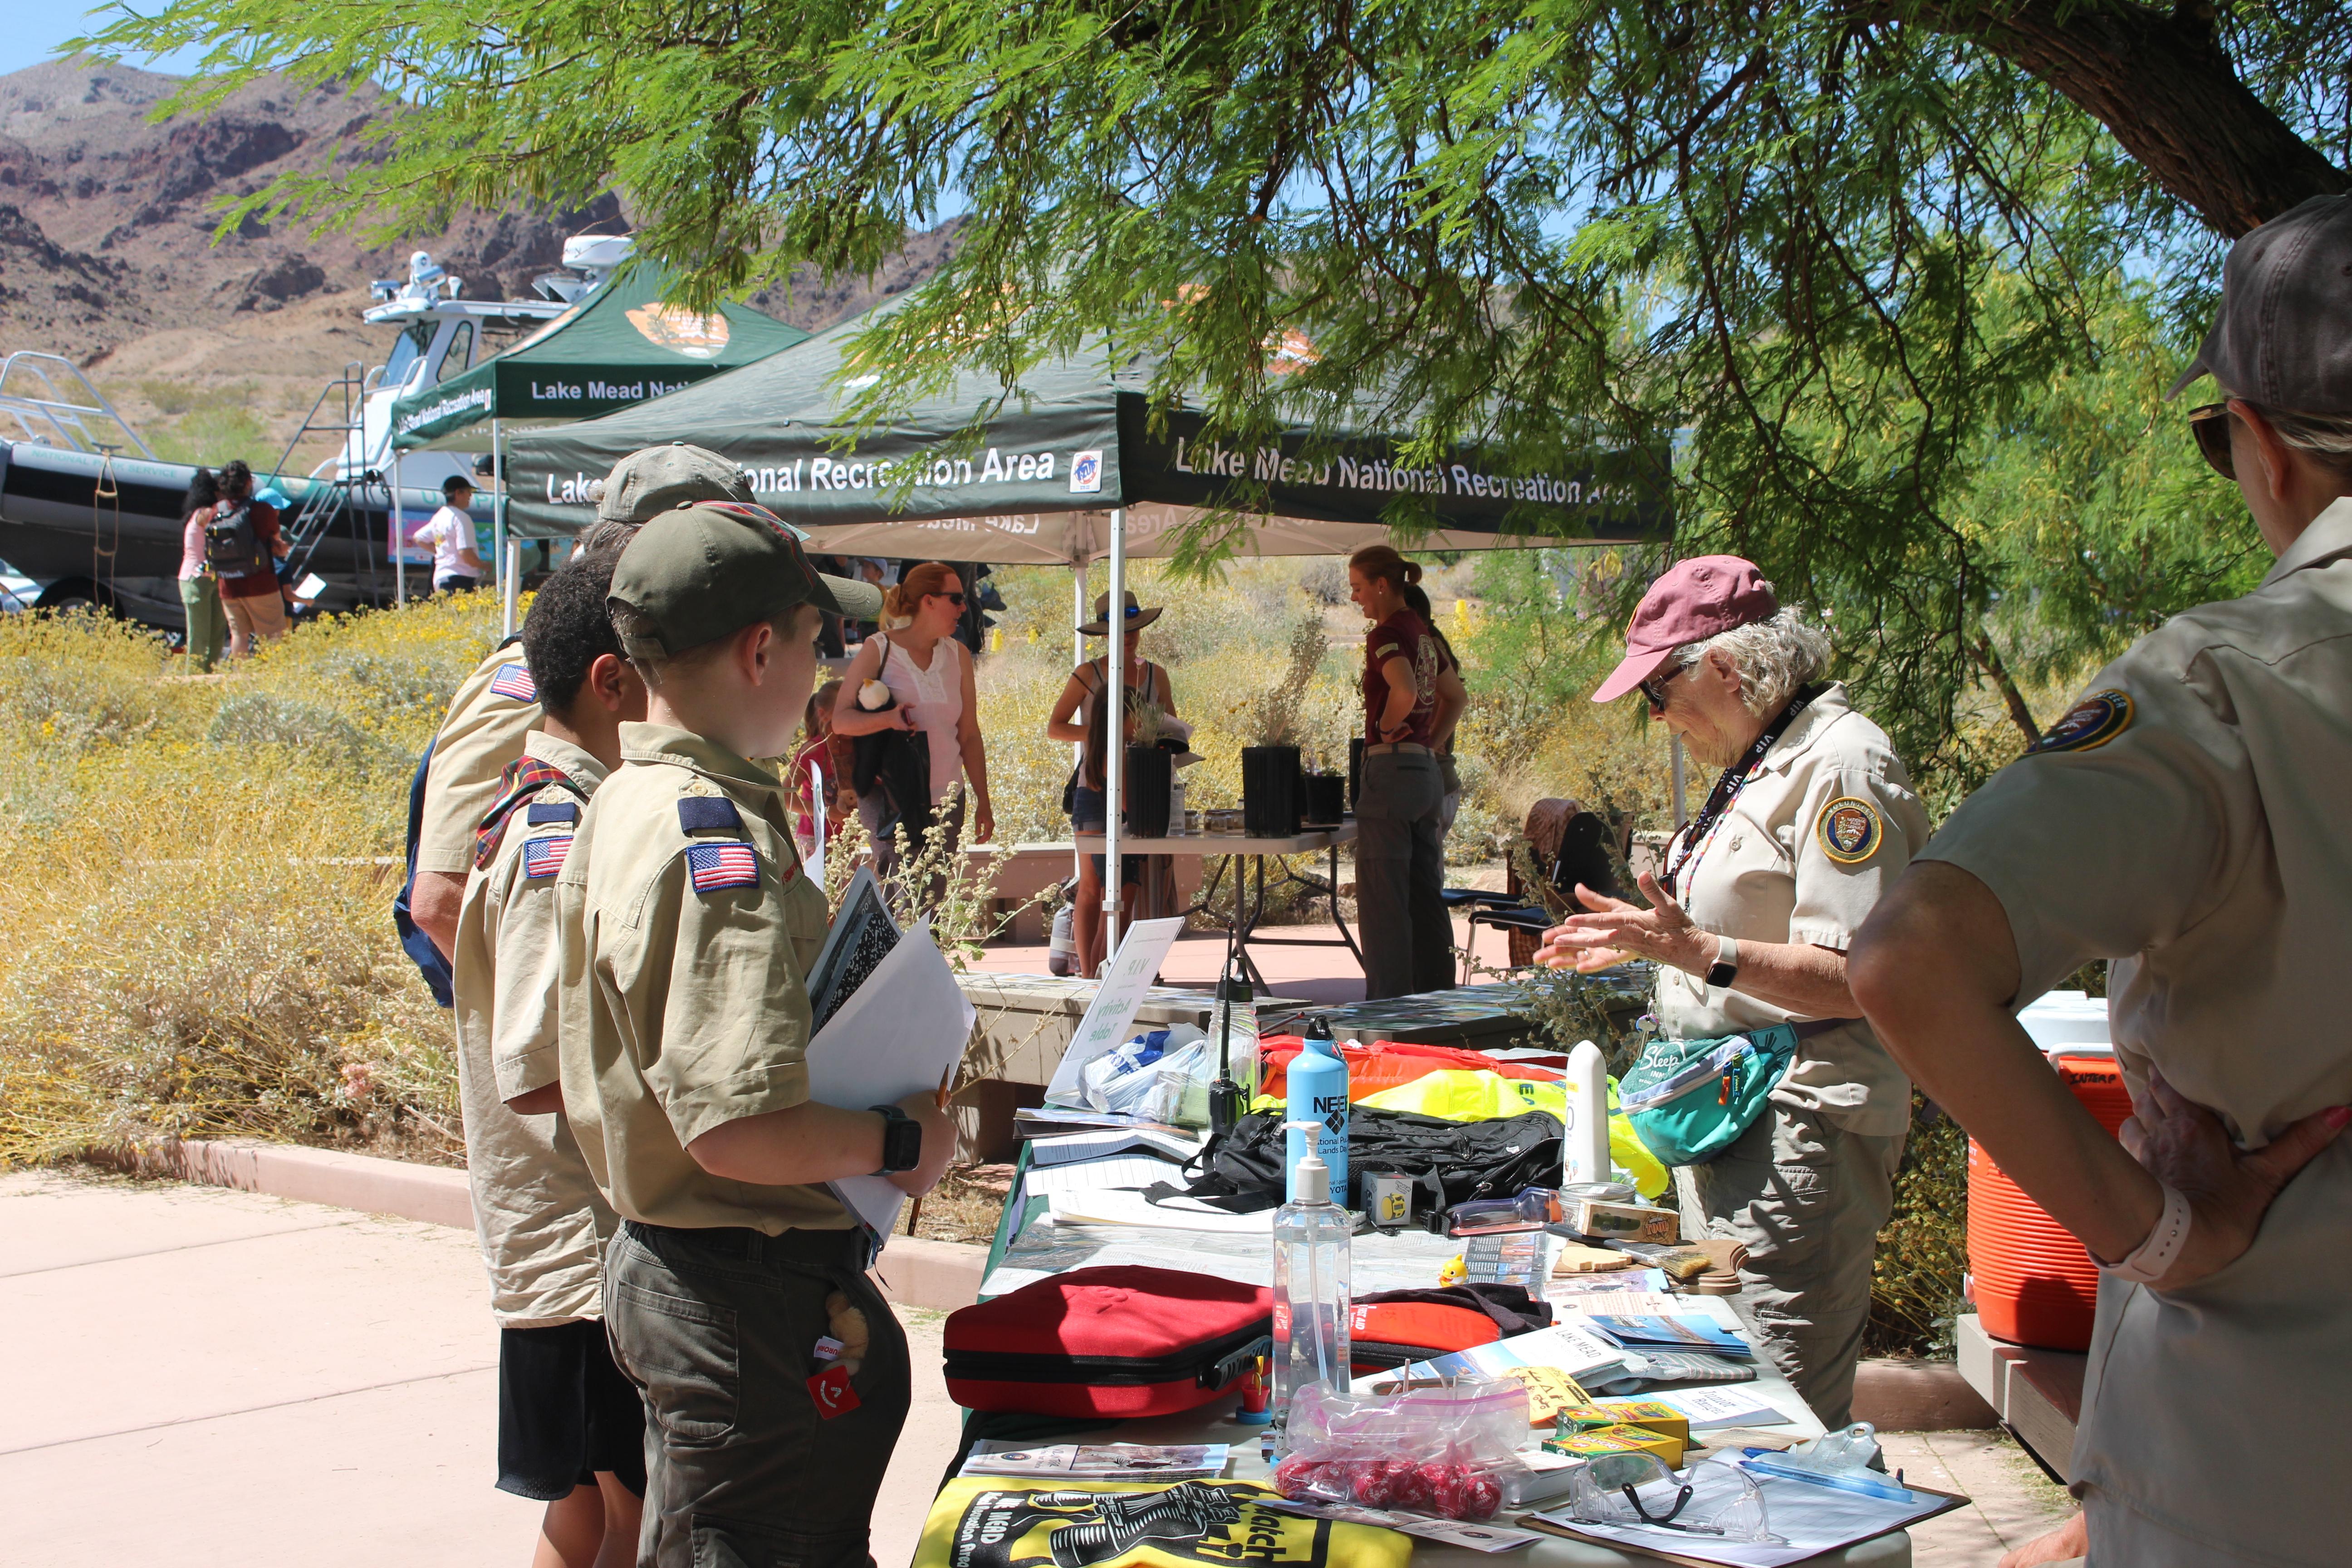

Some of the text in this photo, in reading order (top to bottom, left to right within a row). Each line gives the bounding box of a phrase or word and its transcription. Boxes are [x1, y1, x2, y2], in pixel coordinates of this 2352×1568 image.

[470, 388, 485, 405] Area
[531, 381, 582, 399] Lake
[588, 381, 643, 399] Mead
[32, 449, 178, 479] NATIONAL PRK SERVICE
[979, 447, 1055, 484] Area
[1451, 464, 1581, 504] Recreation
[1790, 699, 1805, 717] VIP
[1756, 734, 1774, 754] VIP
[1725, 774, 1743, 794] VIP
[1827, 800, 1875, 819] VOLUNTEER
[1639, 1045, 1680, 1072] Sleep
[2069, 1073, 2117, 1085] INTERP
[1318, 1146, 1338, 1154] Lands
[1646, 1220, 1669, 1235] TOOL
[1355, 1314, 1367, 1330] AID
[817, 1345, 839, 1356] URORA
[1555, 1329, 1602, 1358] LAKE MEAD
[1568, 1385, 1584, 1402] Survival
[1698, 1390, 1737, 1407] Junior
[1649, 1403, 1674, 1418] Crayola
[1692, 1397, 1725, 1415] Ranger
[1573, 1435, 1624, 1450] CRAYONS
[1624, 1426, 1664, 1441] Crayola
[960, 1505, 990, 1542] Recreation
[980, 1511, 1013, 1544] MEAD
[956, 1543, 977, 1568] Area
